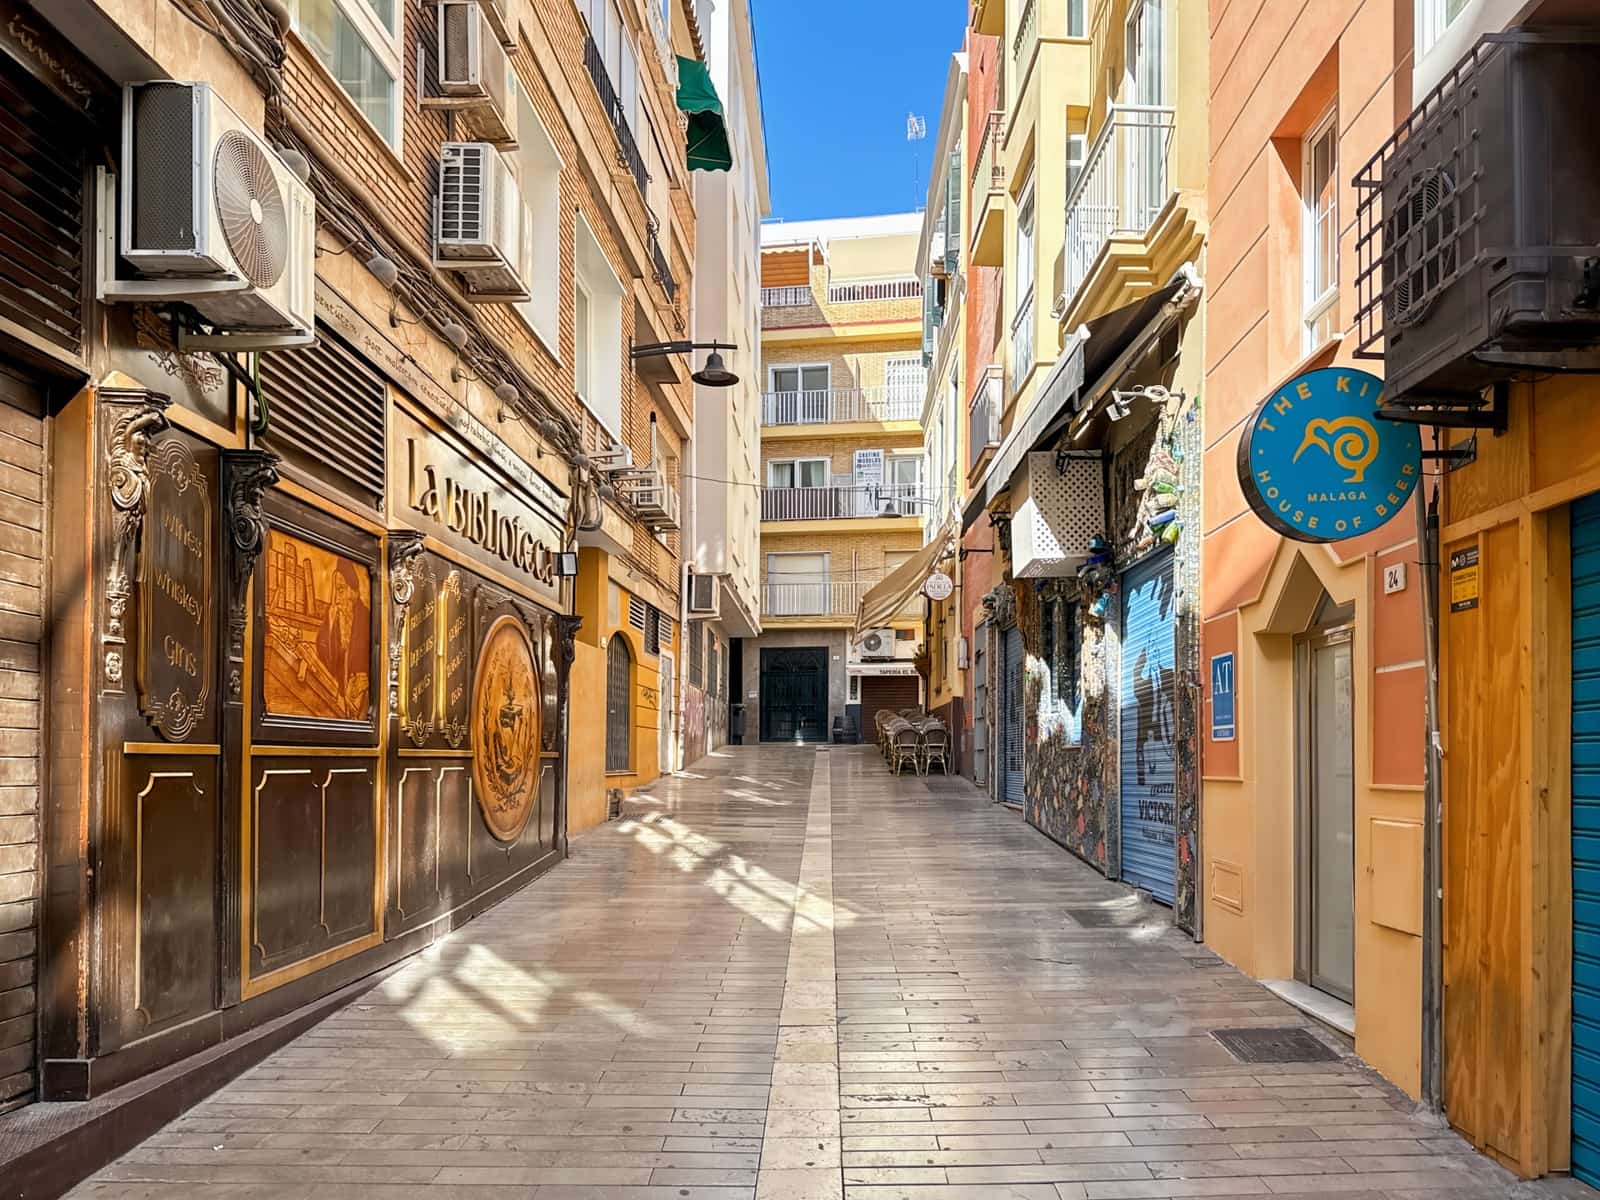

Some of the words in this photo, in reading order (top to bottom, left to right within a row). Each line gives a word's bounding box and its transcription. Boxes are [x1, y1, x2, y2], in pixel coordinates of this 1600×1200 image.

[1258, 382, 1312, 432] THE
[1258, 470, 1319, 528] HOUSE
[1335, 516, 1363, 531] OF
[1375, 464, 1414, 517] BEER
[1307, 491, 1367, 503] MALAGA
[1388, 568, 1399, 588] 24
[1214, 660, 1232, 695] AT
[1138, 799, 1176, 825] VICTORI
